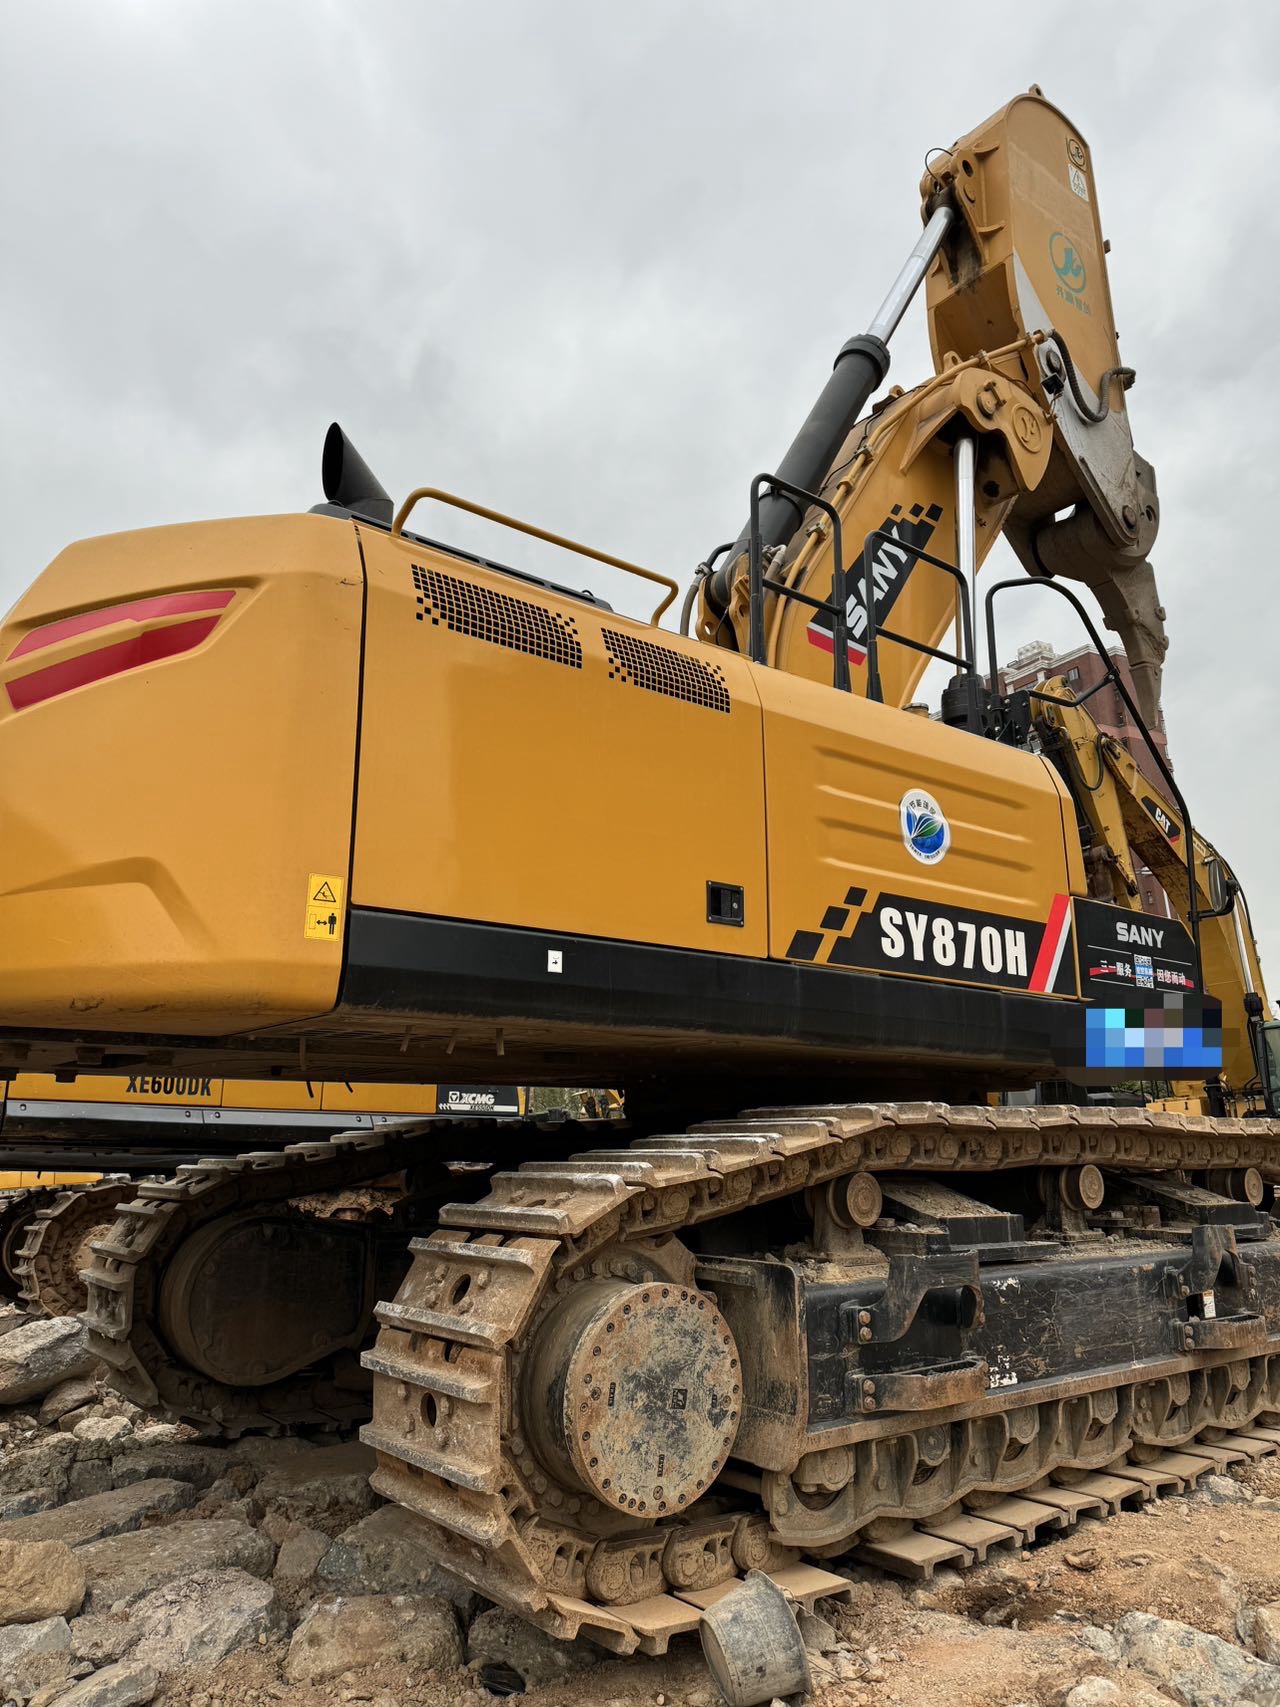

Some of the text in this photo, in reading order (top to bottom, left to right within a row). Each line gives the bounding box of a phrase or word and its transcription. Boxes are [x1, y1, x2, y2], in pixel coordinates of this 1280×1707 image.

[846, 525, 908, 639] SANY
[1155, 807, 1171, 834] CAT
[879, 906, 1028, 977] SY870H
[1116, 921, 1164, 949] SANY
[1100, 959, 1132, 978] 三一服务
[1156, 968, 1186, 986] 因您而动
[126, 1075, 212, 1097] XE600DK
[460, 1093, 495, 1105] XCMG
